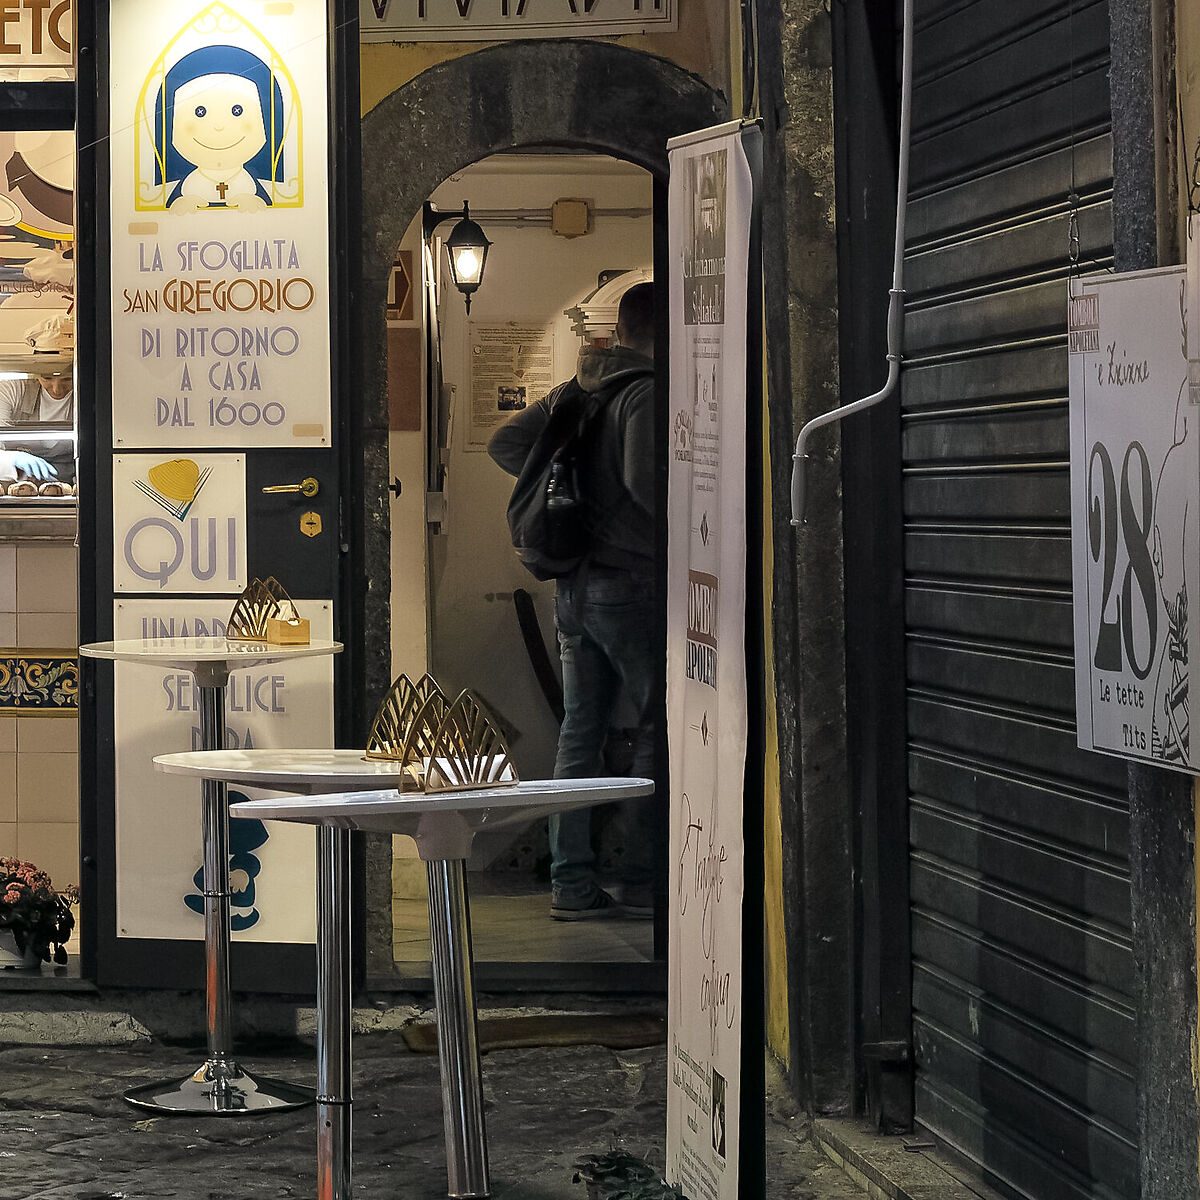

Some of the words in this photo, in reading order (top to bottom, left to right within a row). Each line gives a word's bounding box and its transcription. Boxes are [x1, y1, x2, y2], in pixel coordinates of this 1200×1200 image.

[140, 240, 165, 273] LA
[177, 239, 300, 273] SFOGLIATA
[123, 286, 159, 314] SAN
[162, 278, 315, 314] GREGORIO
[141, 327, 161, 359] DI
[176, 325, 300, 359] RITORNO
[180, 362, 193, 392] A
[208, 361, 263, 393] CASA
[156, 397, 195, 428] DAL
[208, 396, 287, 428] 1600
[124, 516, 237, 590] QUI
[1087, 440, 1159, 681] 28
[162, 674, 286, 713] SELICE
[1099, 679, 1111, 702] Le
[1116, 682, 1145, 709] tette
[1122, 723, 1147, 750] Tits
